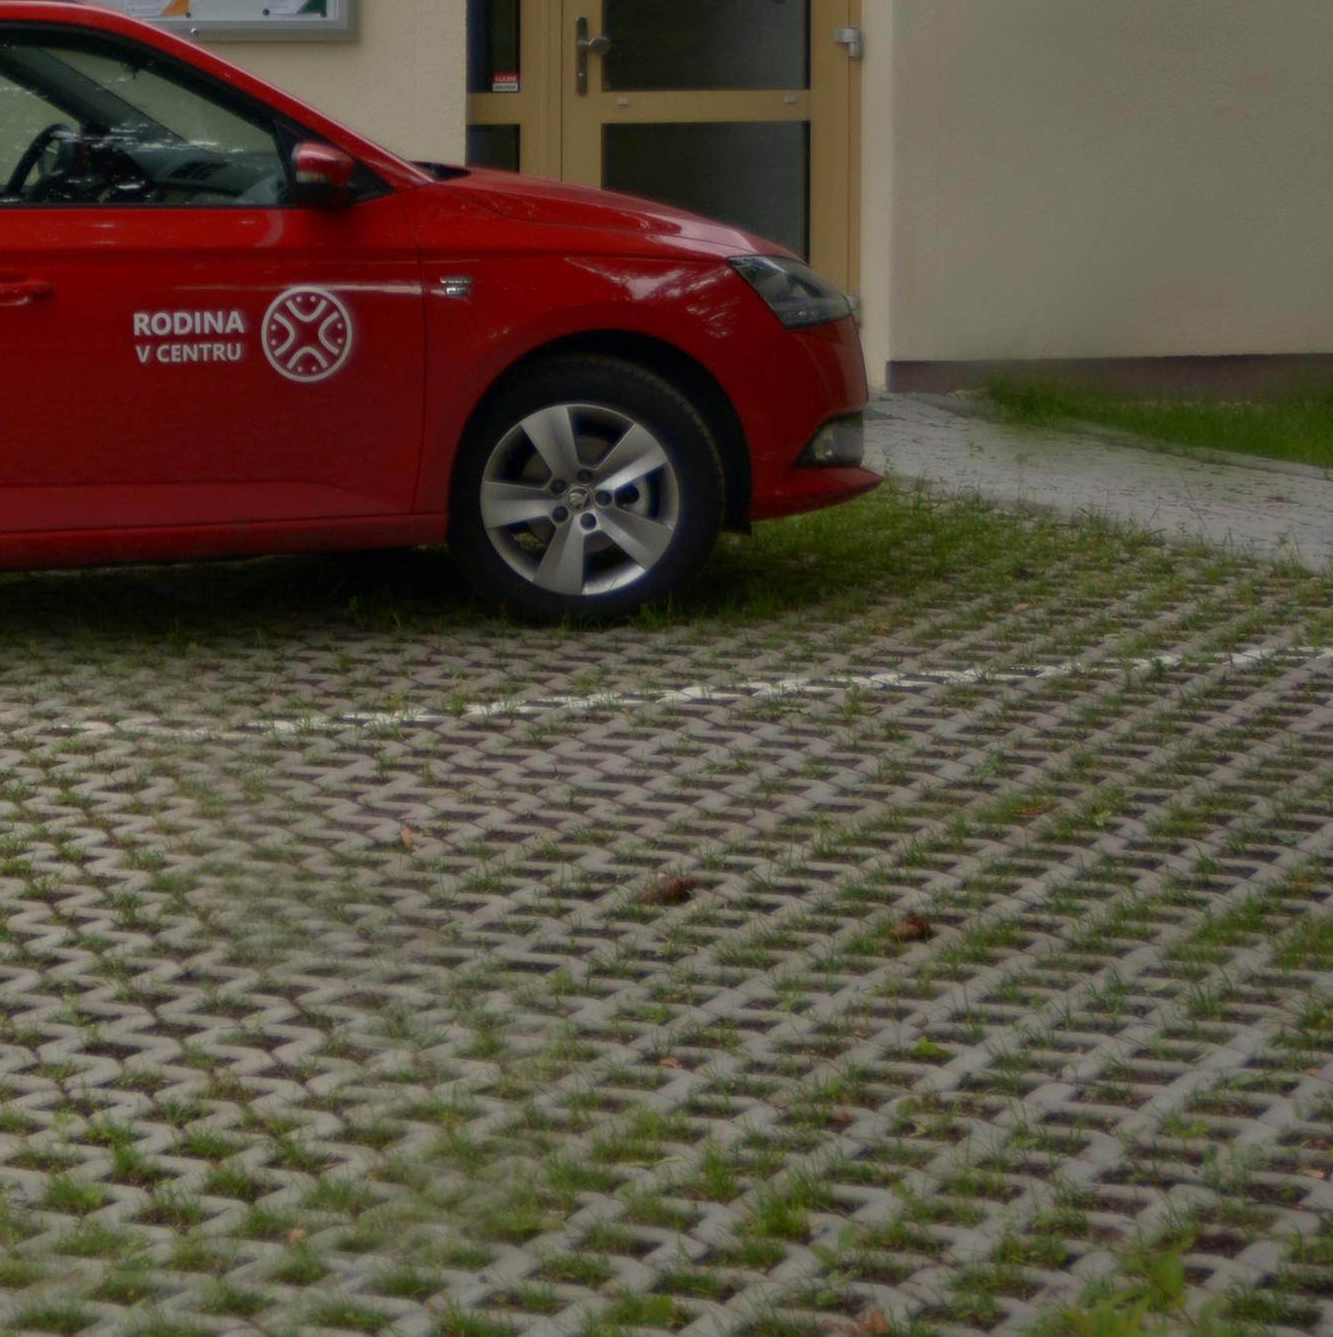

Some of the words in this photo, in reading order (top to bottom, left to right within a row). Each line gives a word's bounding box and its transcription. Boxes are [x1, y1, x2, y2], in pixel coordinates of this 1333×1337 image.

[133, 311, 245, 336] RODINA
[135, 345, 151, 363] V
[156, 343, 242, 363] CENTRU
